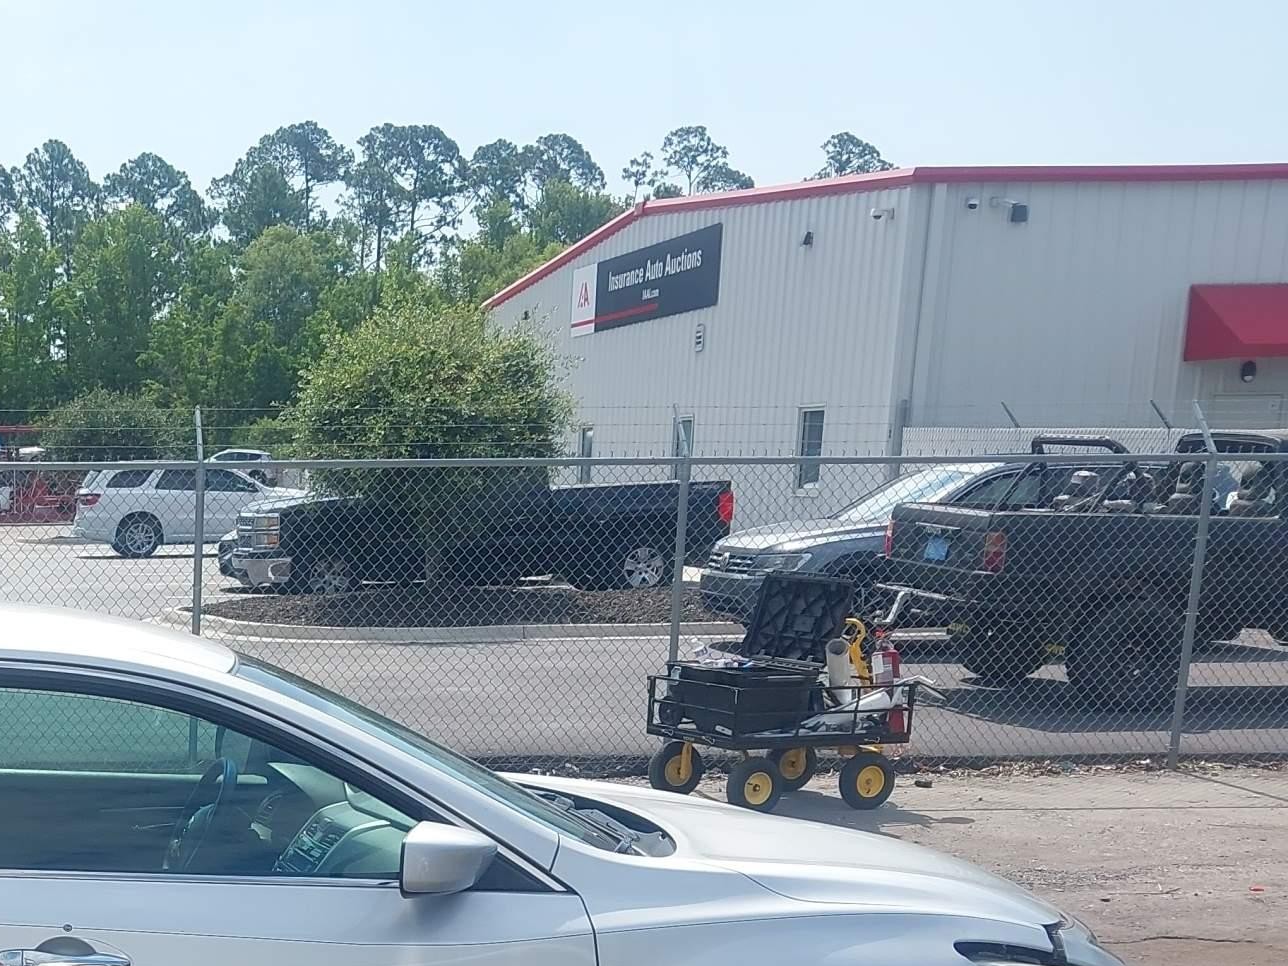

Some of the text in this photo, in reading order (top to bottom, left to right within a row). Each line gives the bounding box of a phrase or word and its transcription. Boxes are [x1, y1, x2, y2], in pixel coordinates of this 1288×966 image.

[608, 248, 702, 292] Insurance Auto Auctions
